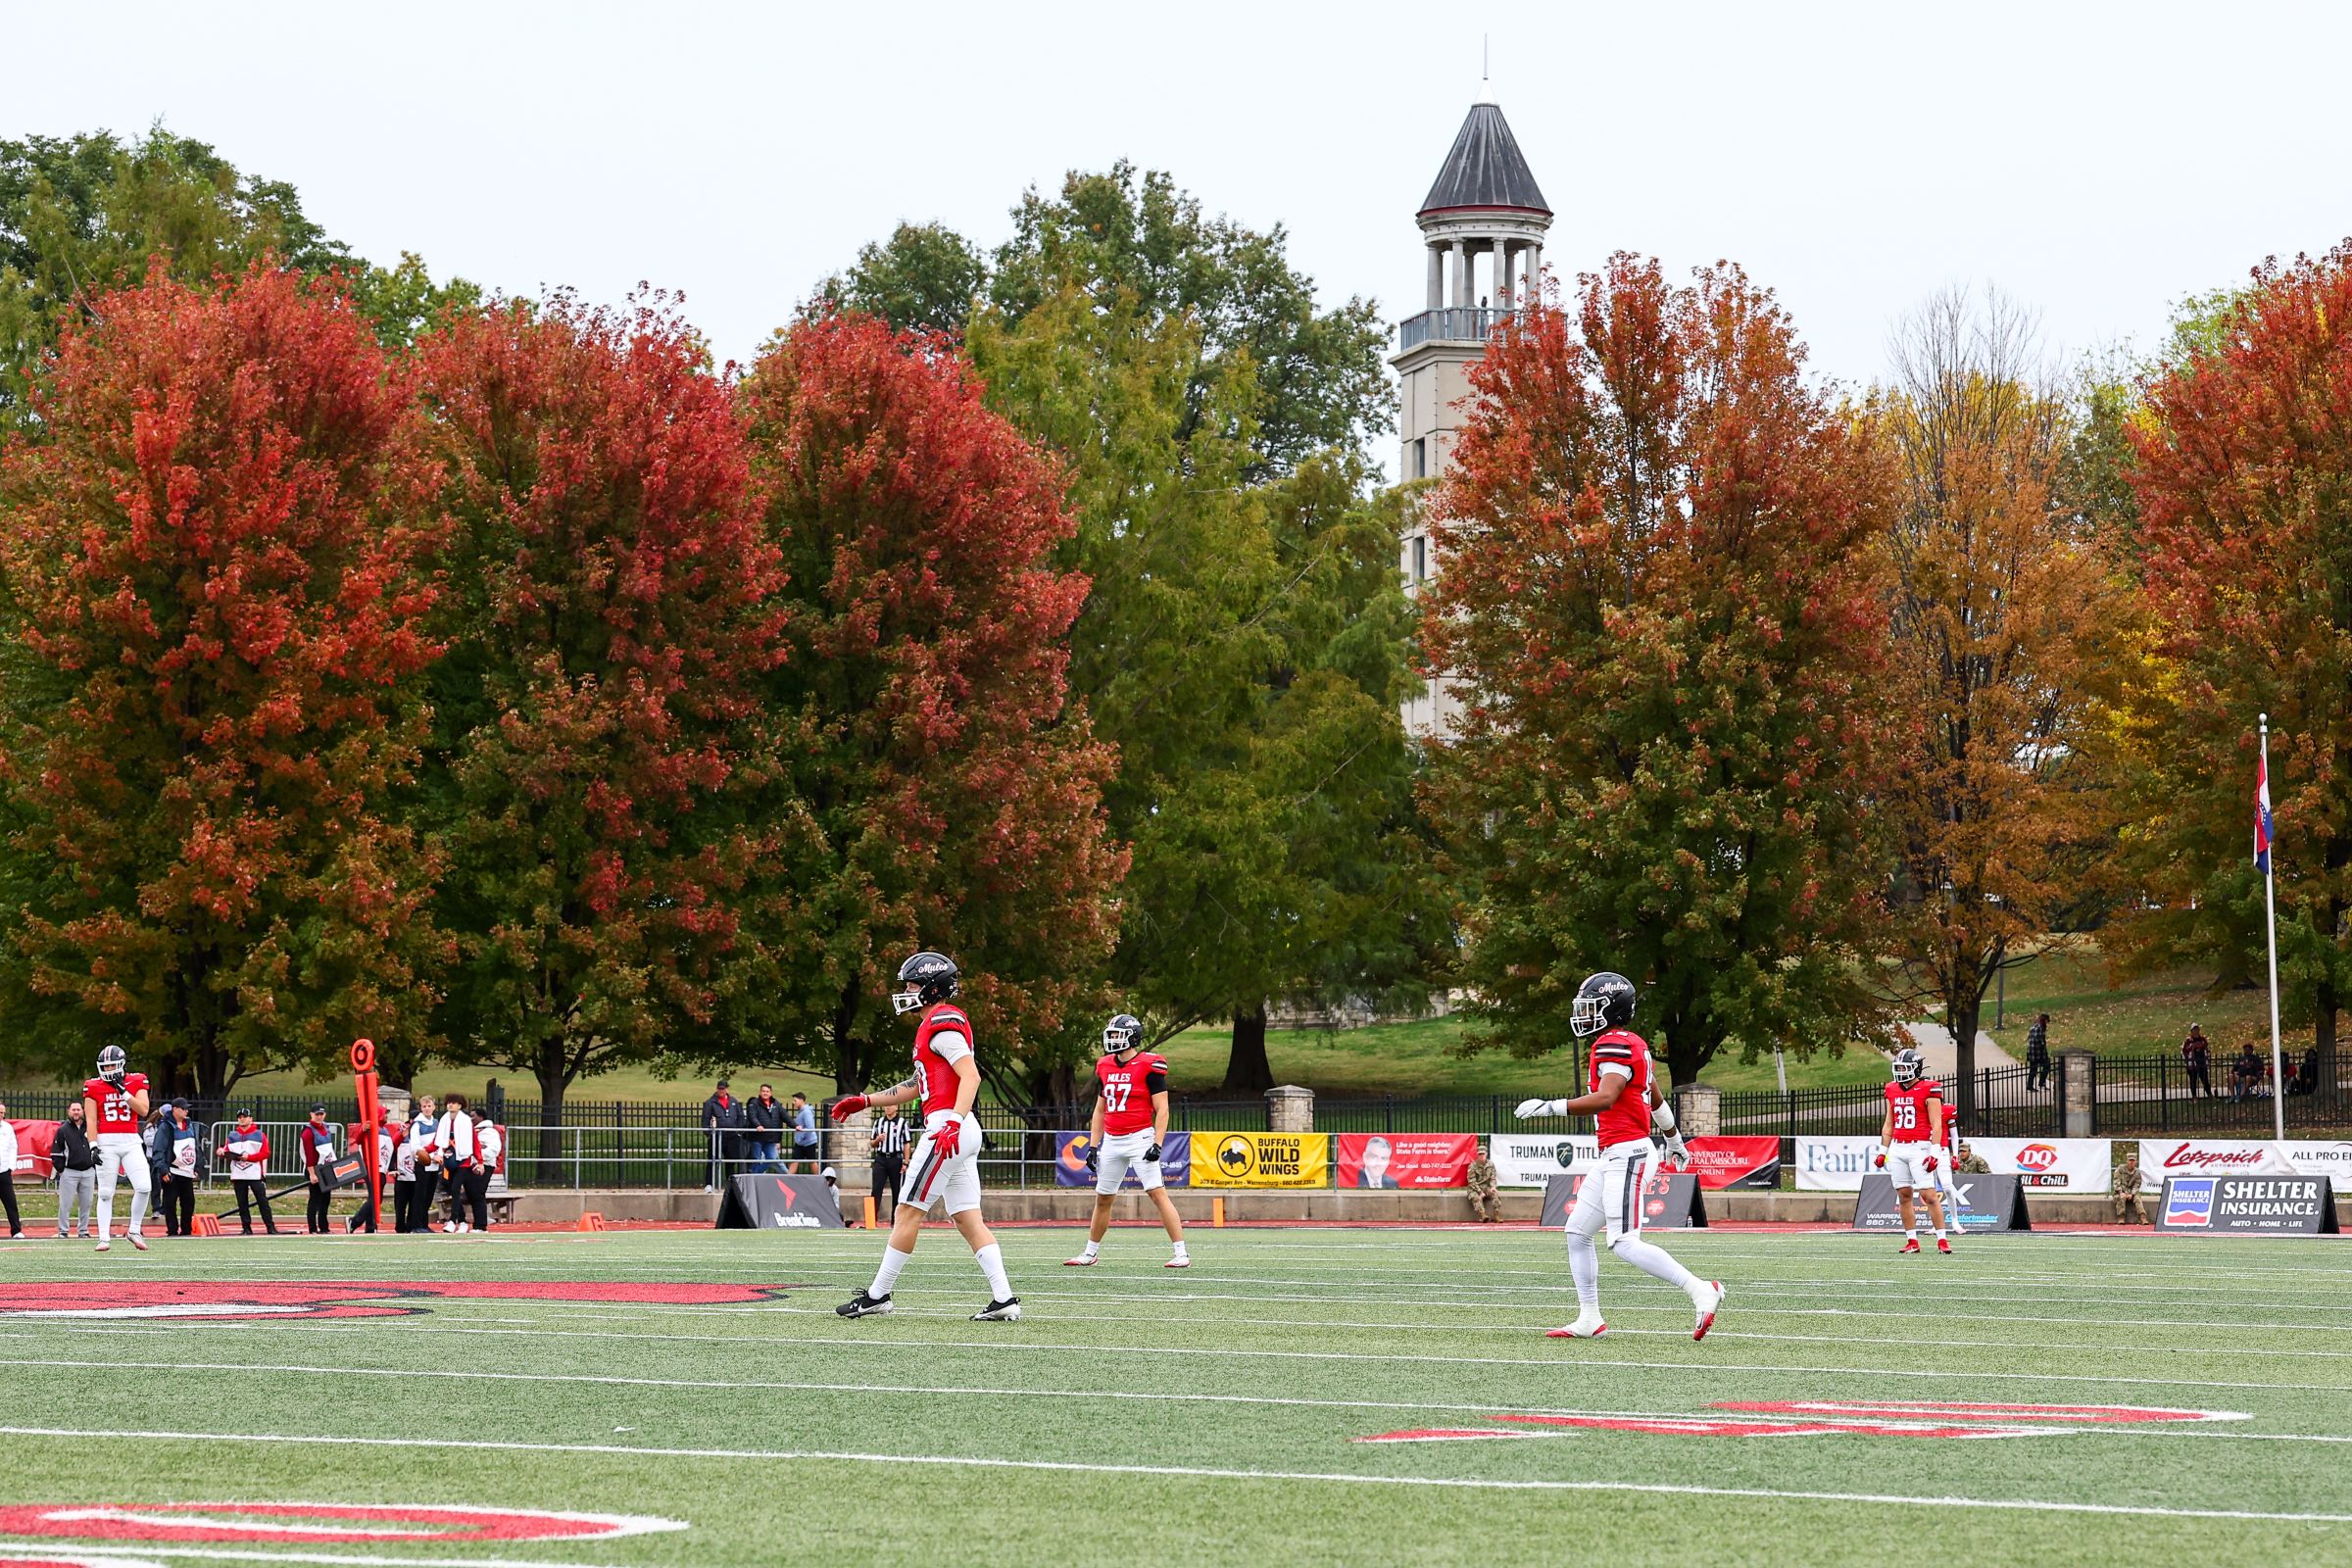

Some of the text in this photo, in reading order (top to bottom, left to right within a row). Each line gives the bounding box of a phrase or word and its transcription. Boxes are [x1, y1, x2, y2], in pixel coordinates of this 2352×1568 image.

[918, 962, 949, 973] Mules
[1598, 982, 1629, 994] Mules
[1107, 1074, 1131, 1083] MULES
[1104, 1084, 1132, 1111] 87
[104, 1102, 130, 1121] 53
[1894, 1105, 1916, 1129] 38
[1258, 1138, 1299, 1147] BUFFALO
[1258, 1149, 1299, 1162] WILD
[1510, 1146, 1553, 1158] TRUMAN
[2022, 1150, 2052, 1166] DQ
[2292, 1152, 2313, 1160] ALL
[2316, 1152, 2339, 1160] PRO
[1259, 1164, 1299, 1175] WINGS
[2223, 1182, 2318, 1199] SHELTER
